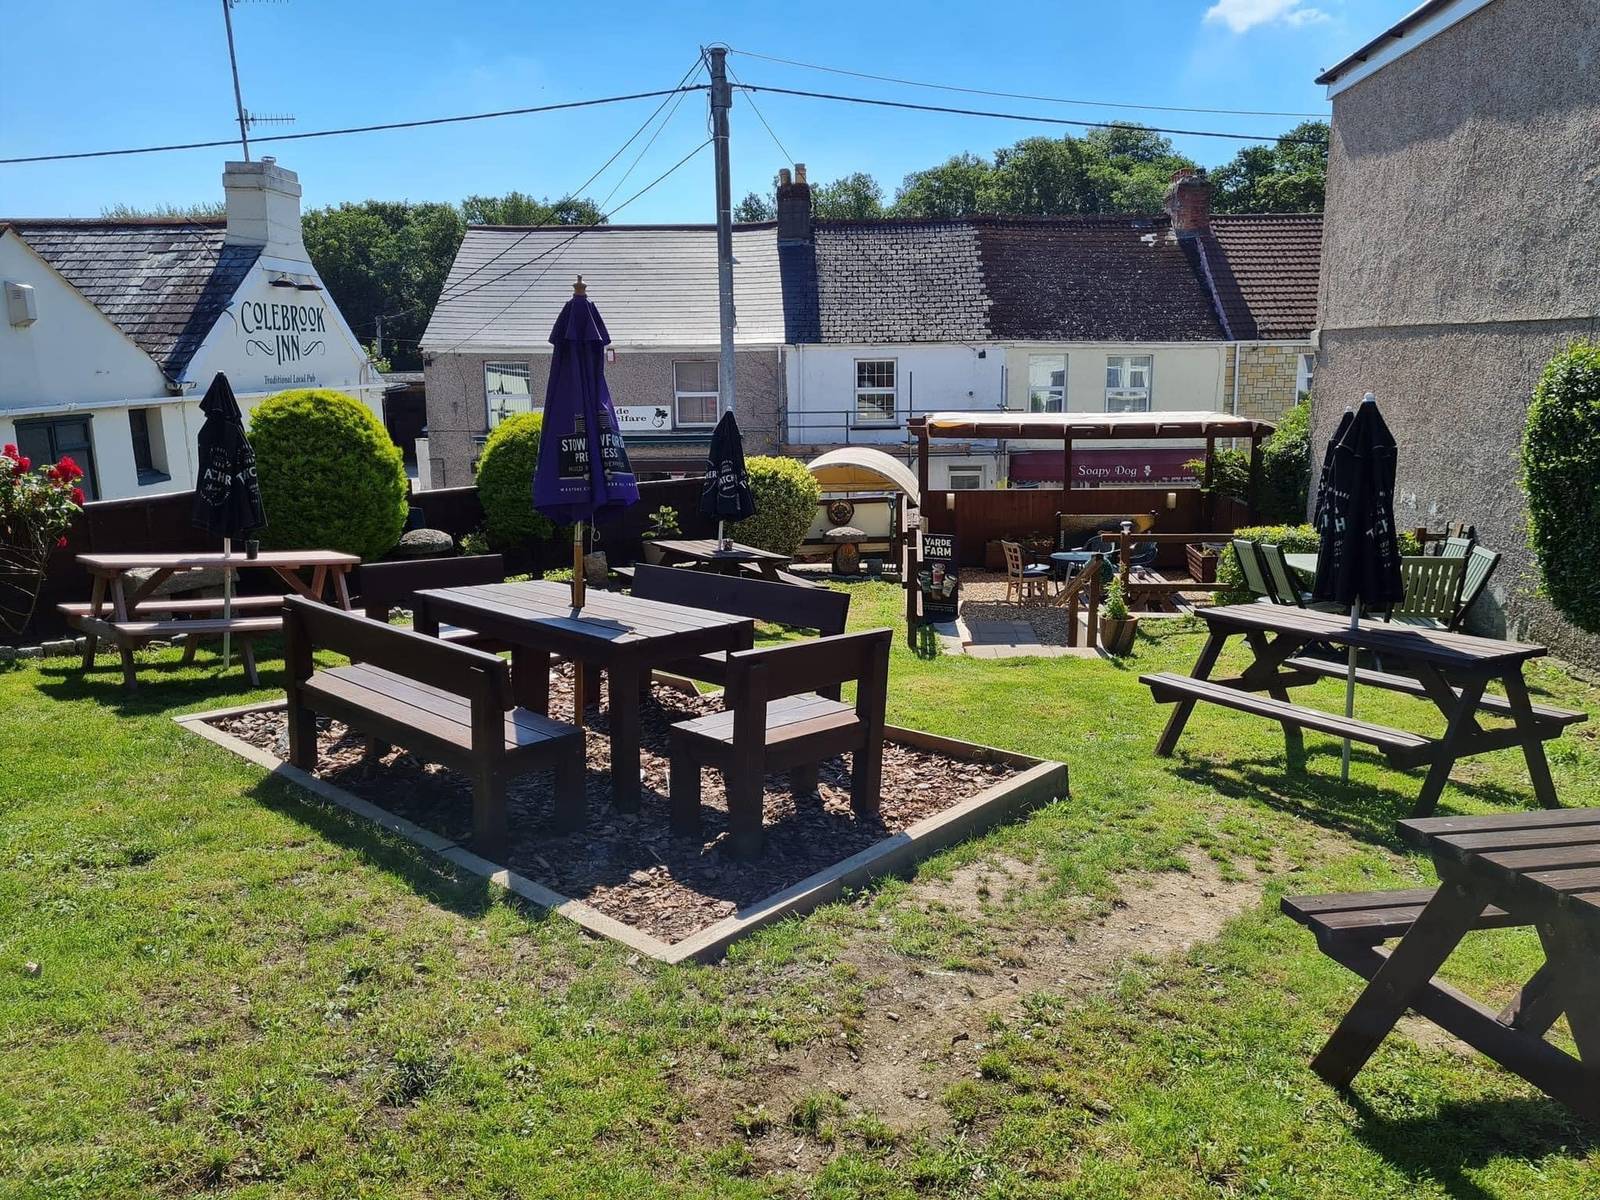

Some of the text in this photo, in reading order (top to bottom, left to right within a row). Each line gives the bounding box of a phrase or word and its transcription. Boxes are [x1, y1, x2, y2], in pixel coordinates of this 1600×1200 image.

[241, 301, 326, 334] COLEBROOK
[276, 334, 300, 365] INN
[264, 373, 316, 384] Traditional Local Pub
[1078, 465, 1137, 478] Soapy Dog
[924, 537, 951, 547] YARDE
[924, 546, 952, 557] FARM
